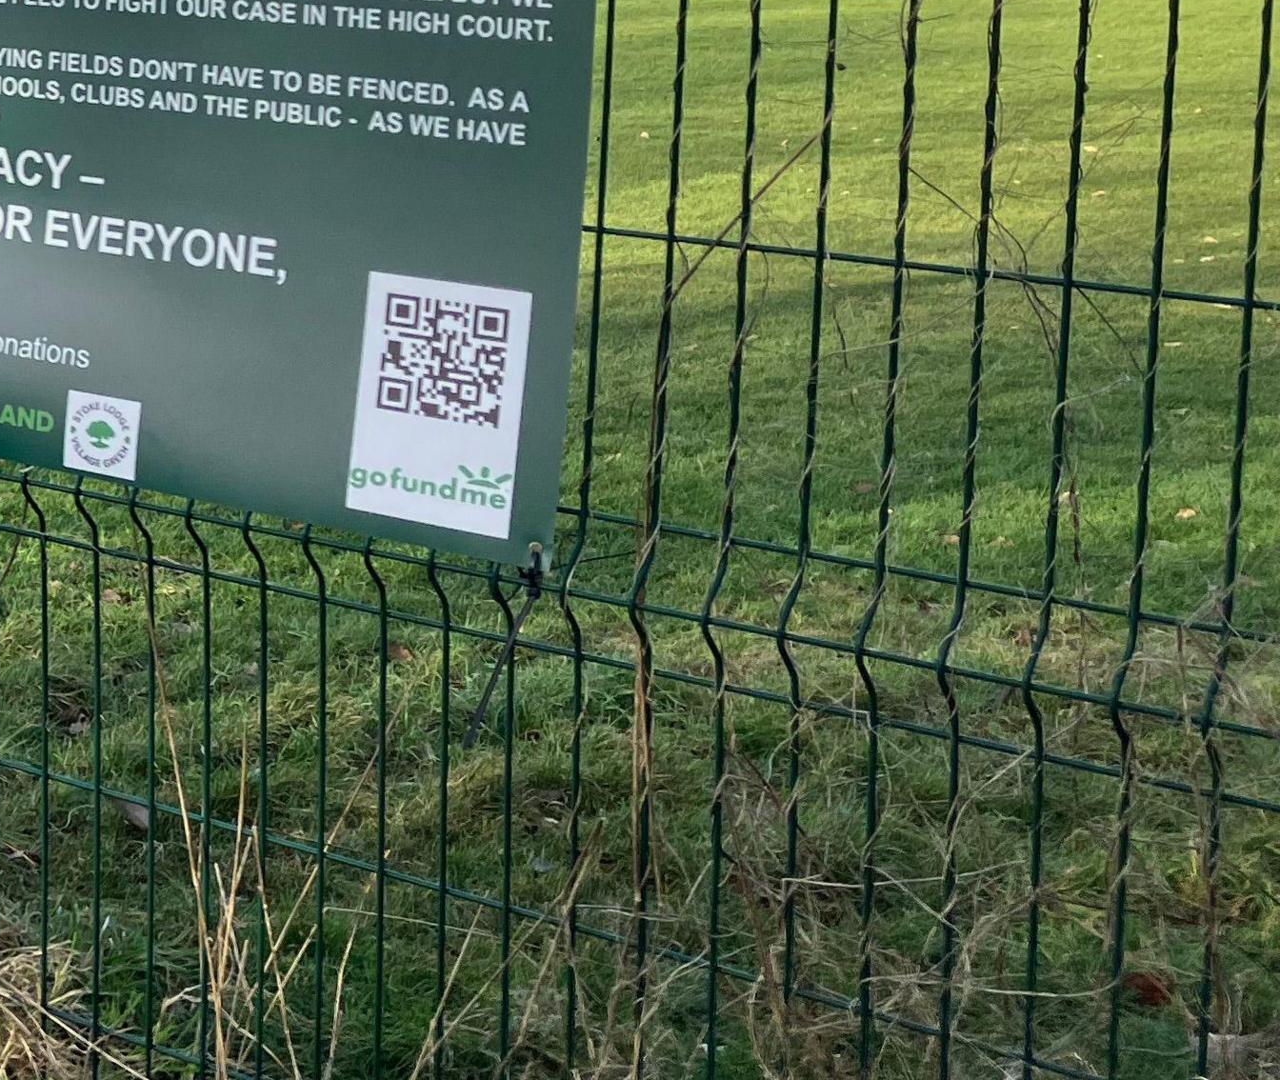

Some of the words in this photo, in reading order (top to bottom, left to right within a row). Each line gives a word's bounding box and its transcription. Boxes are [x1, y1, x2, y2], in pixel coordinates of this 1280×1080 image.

[232, 0, 298, 24] CASE
[303, 4, 327, 26] IN
[333, 6, 382, 30] THE
[388, 9, 450, 35] HIGH
[457, 14, 553, 42] COURT.
[47, 51, 124, 77] FIELDS
[202, 64, 265, 90] HAVE
[269, 69, 303, 93] TO
[308, 73, 342, 96] BE
[348, 76, 455, 107] FENCED.
[467, 87, 505, 111] AS
[509, 90, 530, 113] A
[70, 82, 145, 109] CLUBS
[148, 90, 198, 114] AND
[202, 94, 250, 119] THE
[254, 99, 342, 128] PUBLIC
[368, 110, 403, 134] AS
[409, 114, 450, 139] WE
[456, 118, 526, 146] HAVE
[43, 209, 287, 286] EVERYONE,
[72, 400, 101, 424] STOKE
[103, 401, 131, 431] LODGE
[71, 435, 102, 468] VILLAGE
[102, 445, 129, 468] GREEN
[350, 467, 504, 509] gofundme
